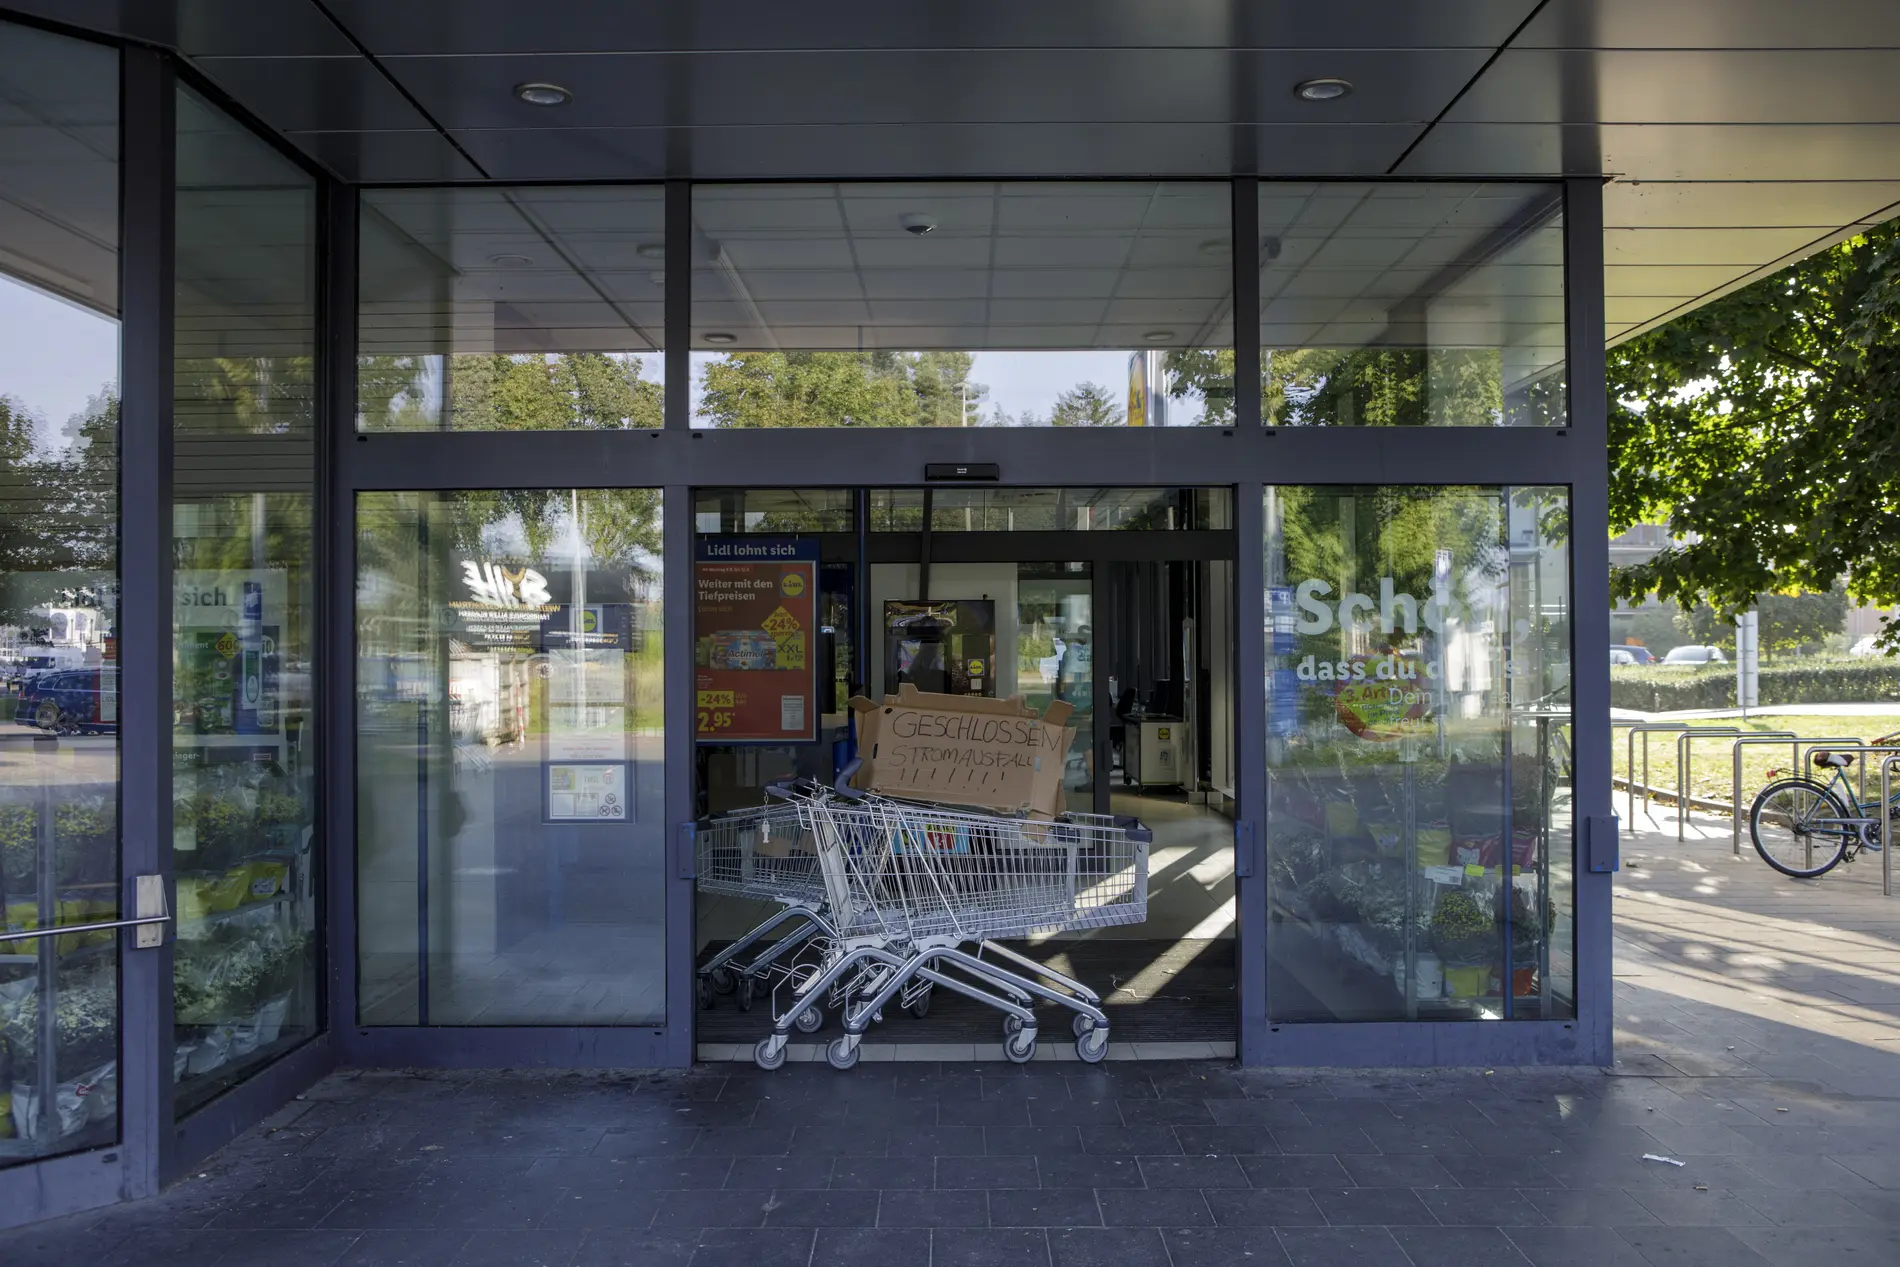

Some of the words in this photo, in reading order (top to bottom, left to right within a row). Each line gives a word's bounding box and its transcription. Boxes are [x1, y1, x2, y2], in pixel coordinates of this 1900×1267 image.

[707, 544, 731, 556] Lidl
[734, 544, 768, 556] lohnt
[770, 544, 796, 556] sich
[698, 579, 734, 589] Weiter
[734, 579, 753, 589] mit
[753, 579, 773, 589] den
[181, 587, 227, 607] sich
[698, 591, 756, 603] Tiefpreisen
[764, 617, 797, 631] -24%
[728, 649, 764, 659] Actimel
[1296, 655, 1366, 681] dass
[1376, 655, 1417, 681] du
[701, 693, 731, 705] -24%
[893, 711, 1060, 751] GESCHLOSSEN
[890, 744, 1033, 767] STROMAUSFALL
